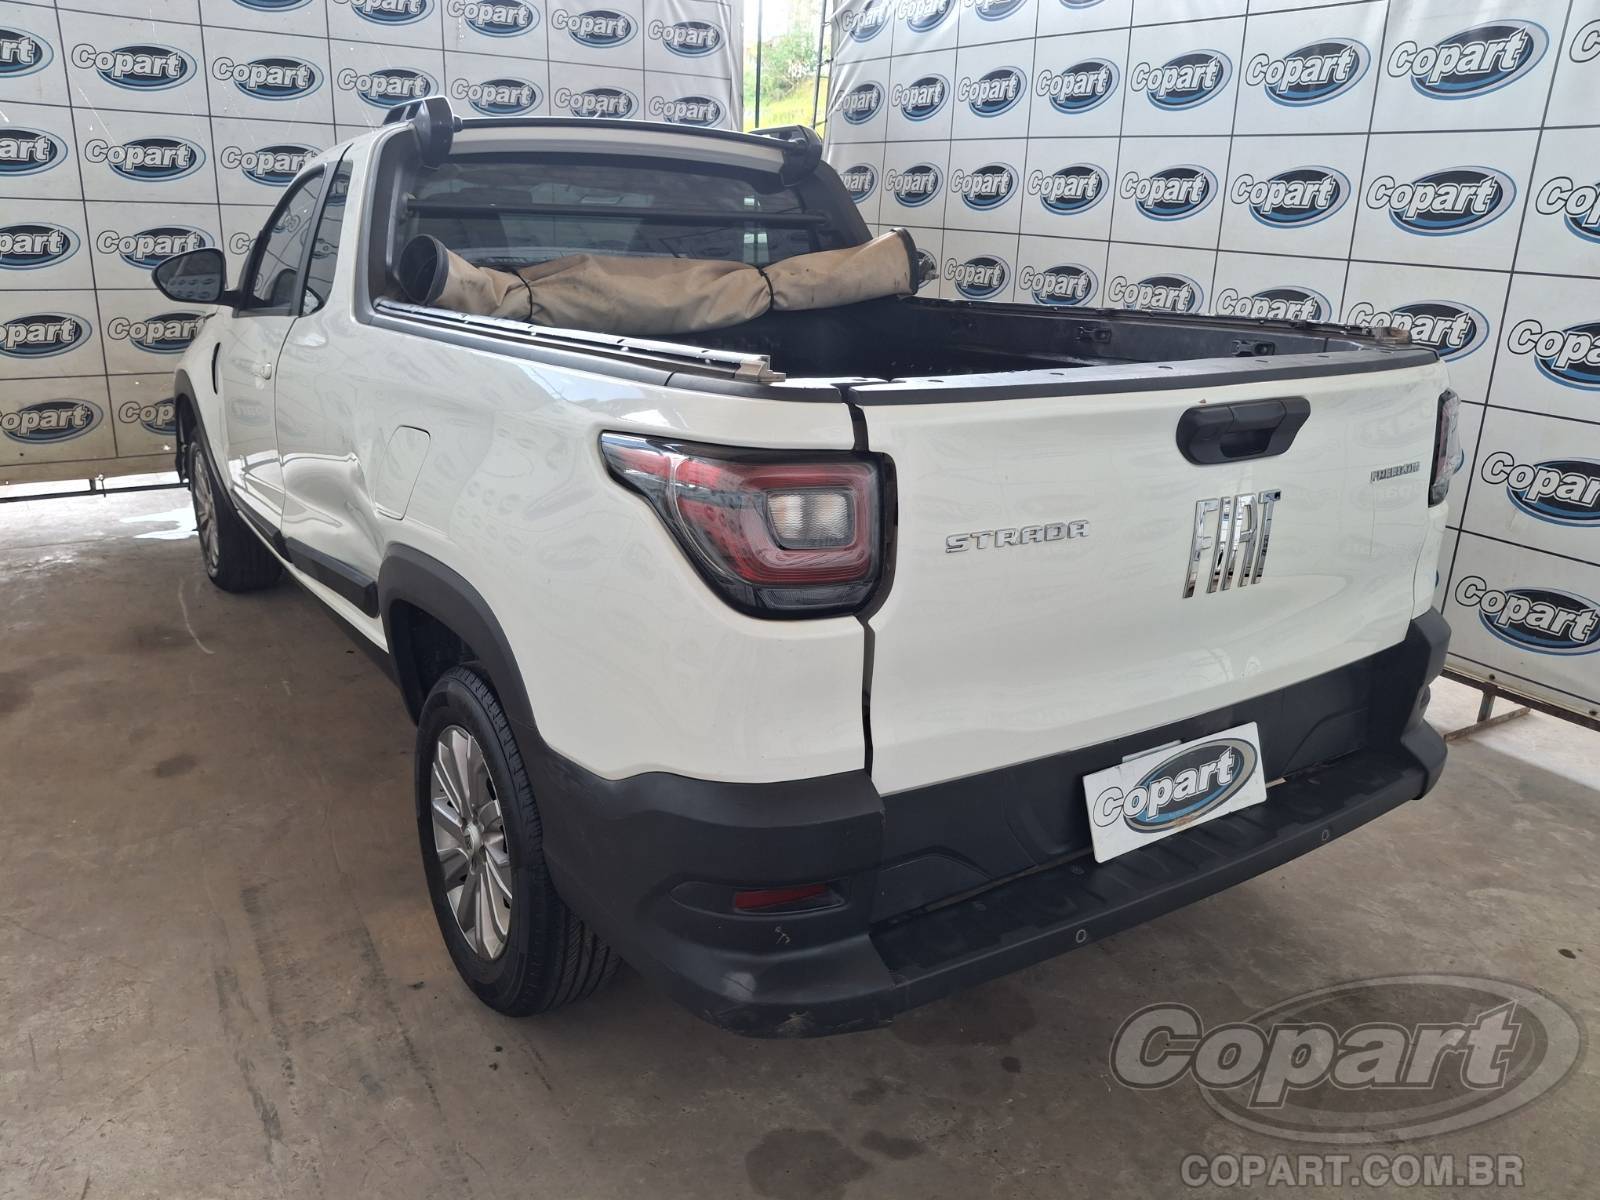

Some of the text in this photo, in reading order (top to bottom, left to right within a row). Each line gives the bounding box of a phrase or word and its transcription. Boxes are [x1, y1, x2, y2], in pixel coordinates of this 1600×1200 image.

[447, 0, 527, 26] Copart
[551, 9, 627, 37] Copart
[648, 20, 717, 47] Copart
[71, 44, 183, 78] Copart
[1246, 45, 1356, 93] Copart
[1387, 26, 1530, 85] Copart
[212, 56, 310, 88] Copart
[337, 68, 426, 99] Copart
[958, 69, 1020, 103] Copart
[1036, 64, 1110, 99] Copart
[1131, 56, 1219, 98] Copart
[451, 78, 532, 106] Copart
[555, 88, 633, 114] Copart
[892, 79, 943, 112] Copart
[649, 96, 717, 121] Copart
[85, 140, 192, 171] Copart
[885, 168, 936, 197] Copart
[951, 168, 1013, 201] Copart
[1028, 169, 1100, 200] Copart
[1120, 170, 1207, 208] Copart
[1231, 174, 1336, 214] Copart
[1366, 175, 1498, 219] Copart
[97, 230, 201, 260] Copart
[944, 257, 1004, 287] Copart
[1019, 266, 1089, 298] Copart
[1108, 276, 1192, 311] Copart
[1216, 288, 1318, 320] Copart
[0, 404, 86, 436] opart
[119, 401, 175, 426] Cop
[1481, 452, 1600, 507] Copar
[945, 519, 1090, 553] STRADA
[1183, 488, 1281, 598] FIAT
[1455, 575, 1600, 642] Copart
[1093, 746, 1235, 827] Copart
